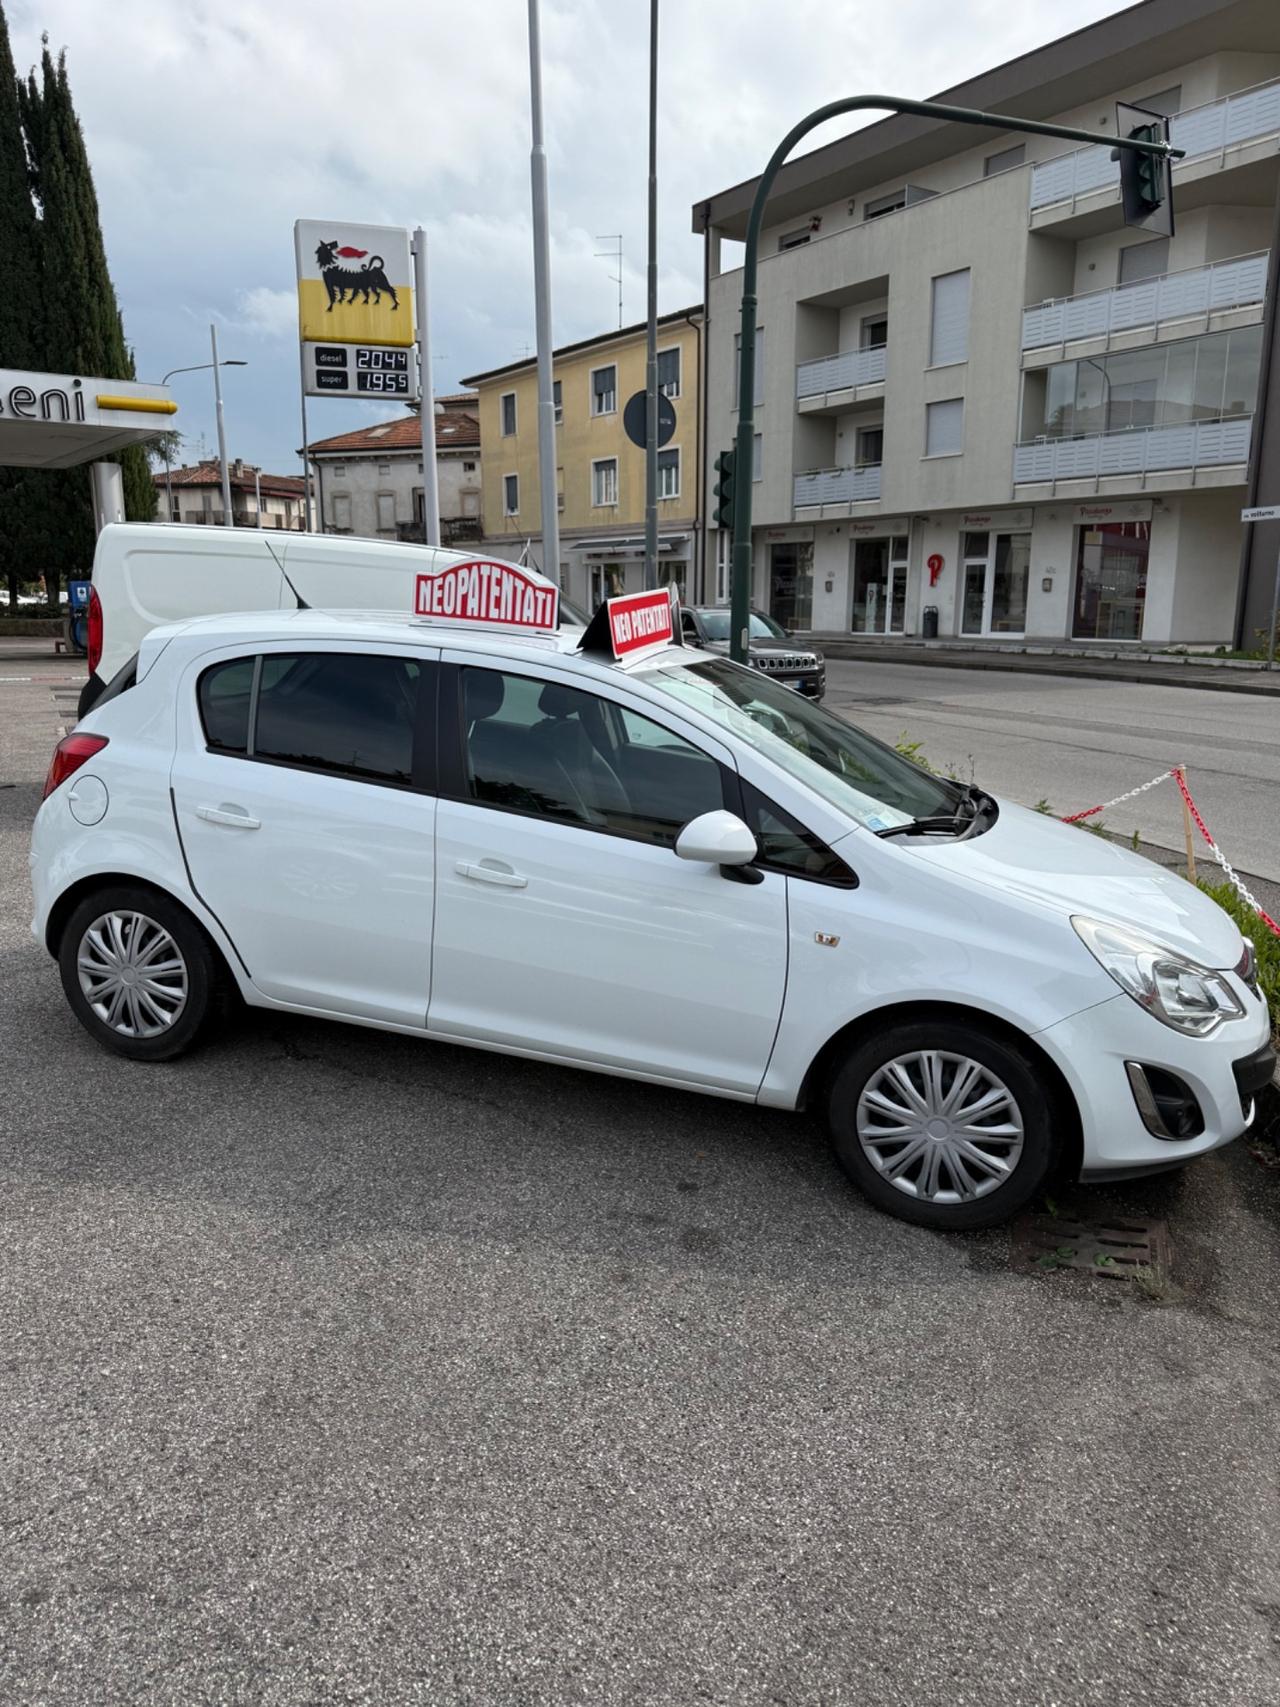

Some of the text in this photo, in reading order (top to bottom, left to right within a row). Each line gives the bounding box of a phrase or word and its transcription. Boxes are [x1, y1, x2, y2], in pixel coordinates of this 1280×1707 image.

[319, 354, 342, 363] diesel
[321, 375, 343, 384] super
[9, 379, 86, 422] eni
[418, 564, 552, 625] NEOPATENTATI
[613, 603, 670, 645] NEO PATENTATI
